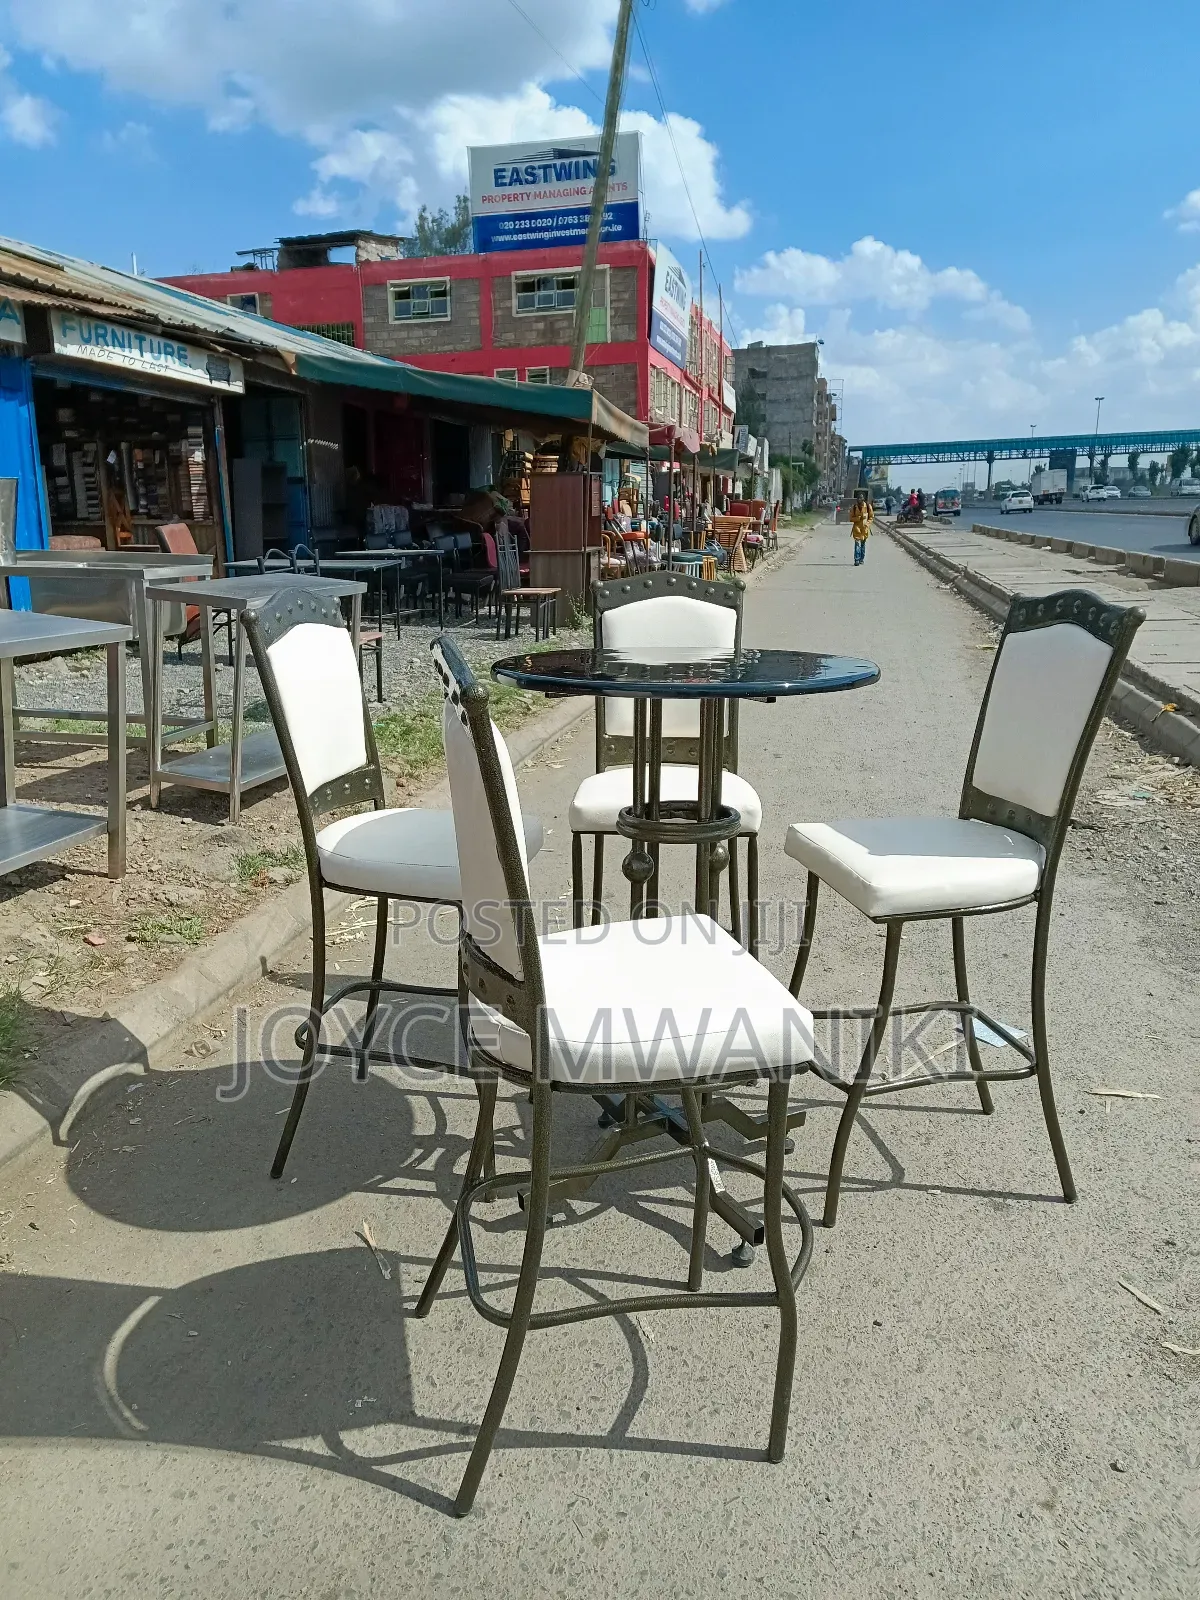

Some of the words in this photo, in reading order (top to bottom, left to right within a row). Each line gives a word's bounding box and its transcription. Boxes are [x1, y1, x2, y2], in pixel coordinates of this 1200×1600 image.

[493, 158, 616, 188] EASTWING
[481, 192, 531, 204] PROPERTY
[533, 186, 587, 201] MANAGING
[499, 221, 514, 230] 020
[515, 220, 530, 229] 233
[531, 218, 552, 228] 0020
[558, 215, 578, 225] 0763
[77, 344, 114, 361] MADE
[122, 354, 136, 366] TO
[141, 359, 170, 373] LAST
